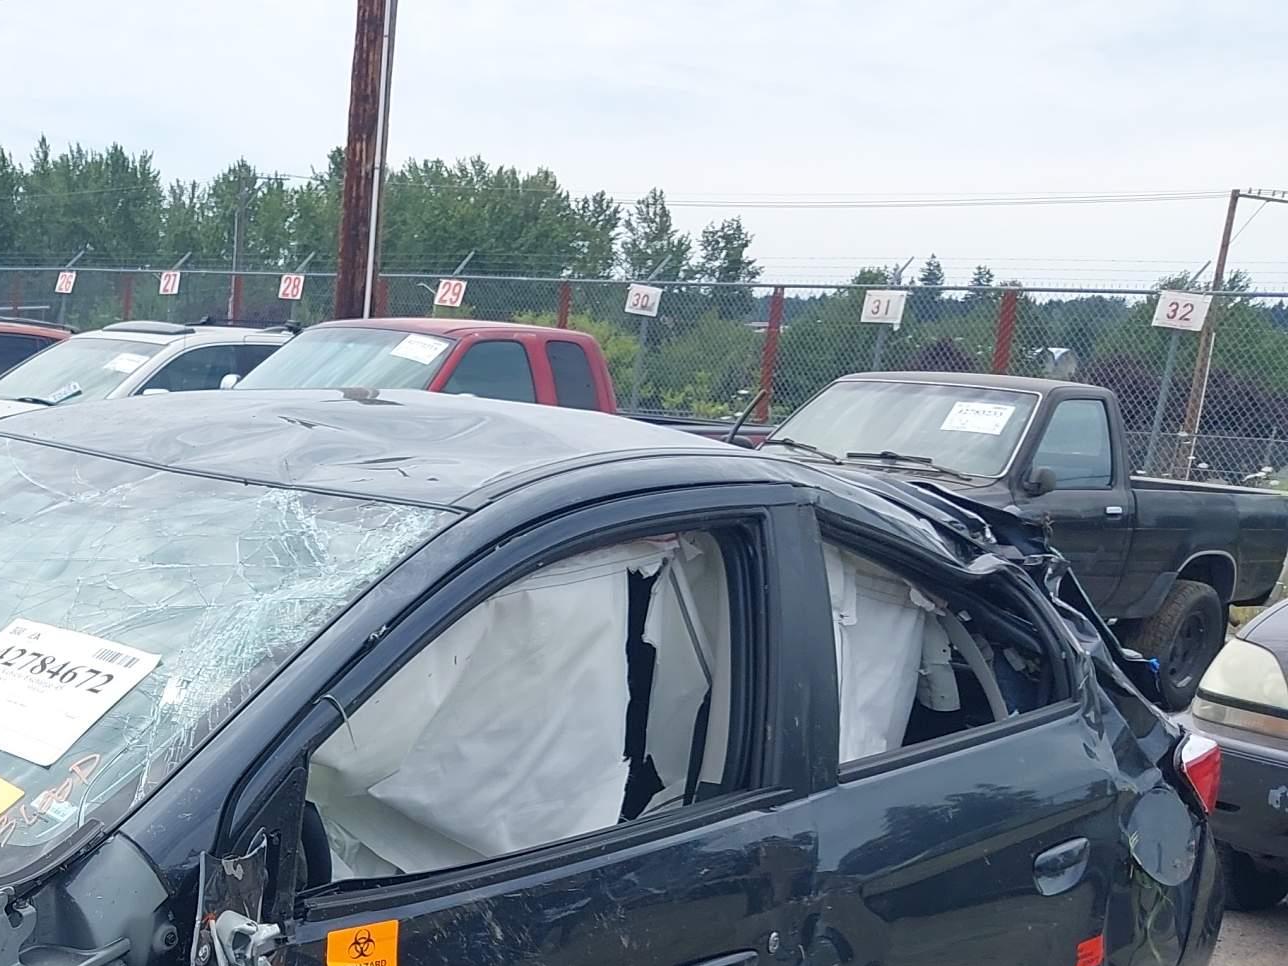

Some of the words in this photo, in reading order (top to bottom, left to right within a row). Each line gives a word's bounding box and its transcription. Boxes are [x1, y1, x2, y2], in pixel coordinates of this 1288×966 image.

[58, 275, 73, 292] 26
[163, 274, 178, 292] 27
[282, 276, 300, 297] 28
[438, 281, 462, 304] 29
[631, 293, 650, 309] 30
[870, 299, 890, 316] 31
[1166, 301, 1195, 321] 32
